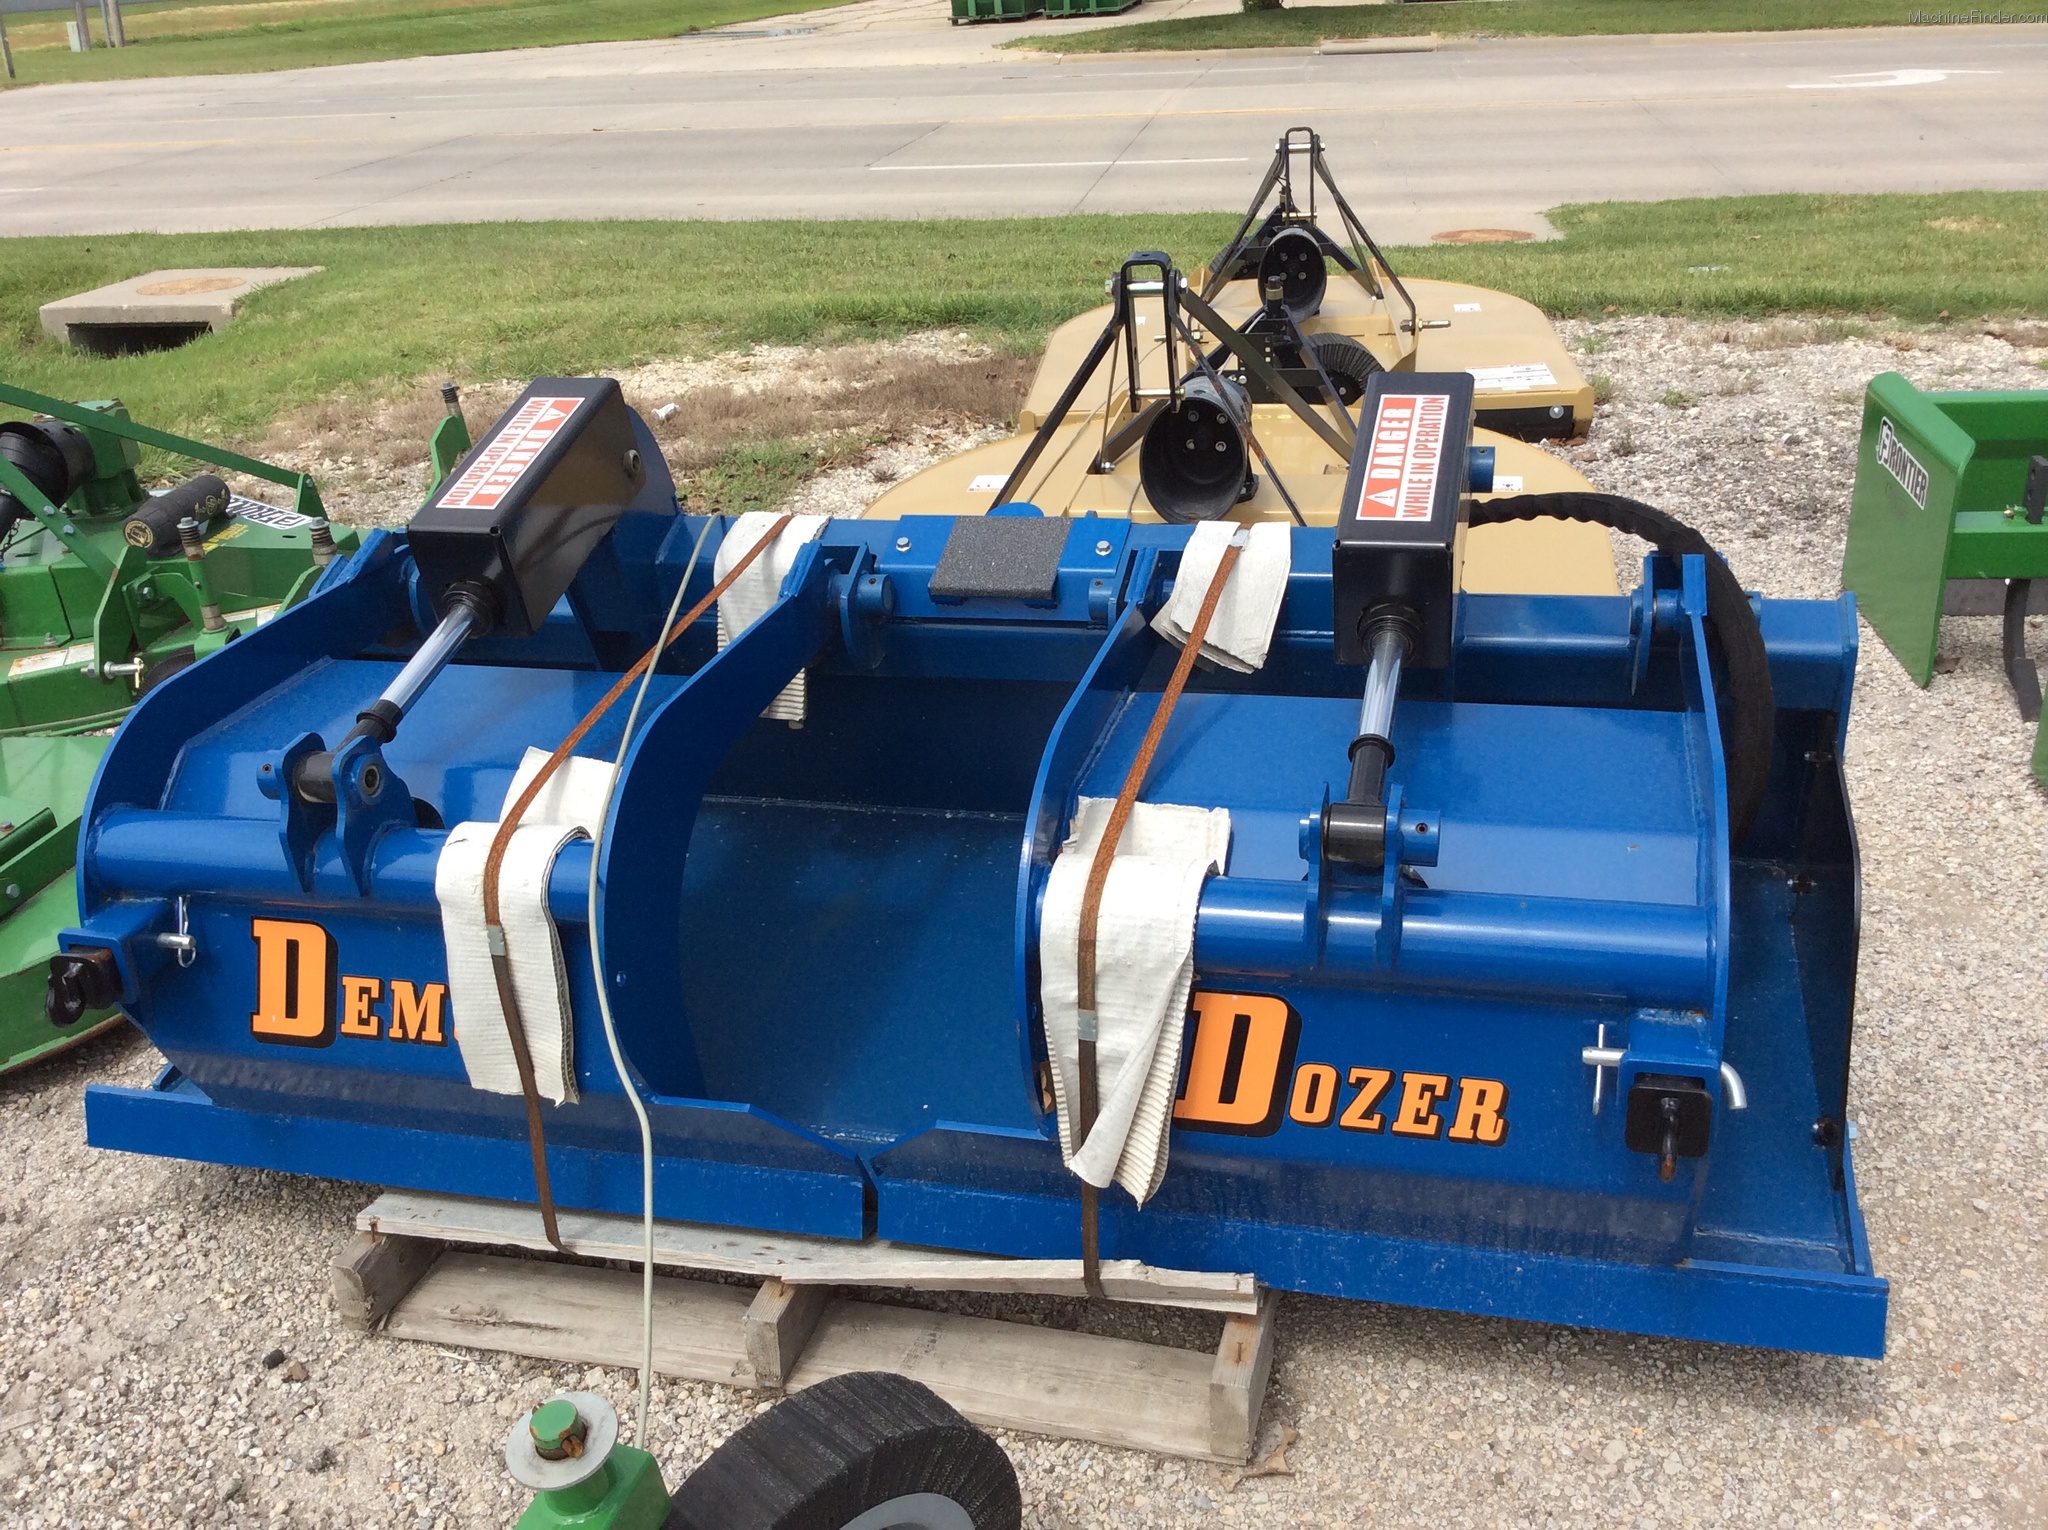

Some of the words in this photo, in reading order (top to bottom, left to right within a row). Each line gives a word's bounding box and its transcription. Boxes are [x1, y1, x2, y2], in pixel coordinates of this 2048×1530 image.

[495, 433, 520, 444] IN
[507, 400, 549, 431] WHILE
[1370, 408, 1412, 479] DANGER
[1413, 397, 1445, 459] OPERATION
[441, 446, 508, 506] OPERATION
[478, 429, 553, 495] DANGER
[1410, 462, 1435, 475] IN
[1878, 417, 1929, 509] FRONTIER
[1402, 478, 1432, 518] WHILE
[1171, 988, 1511, 1148] DOZER
